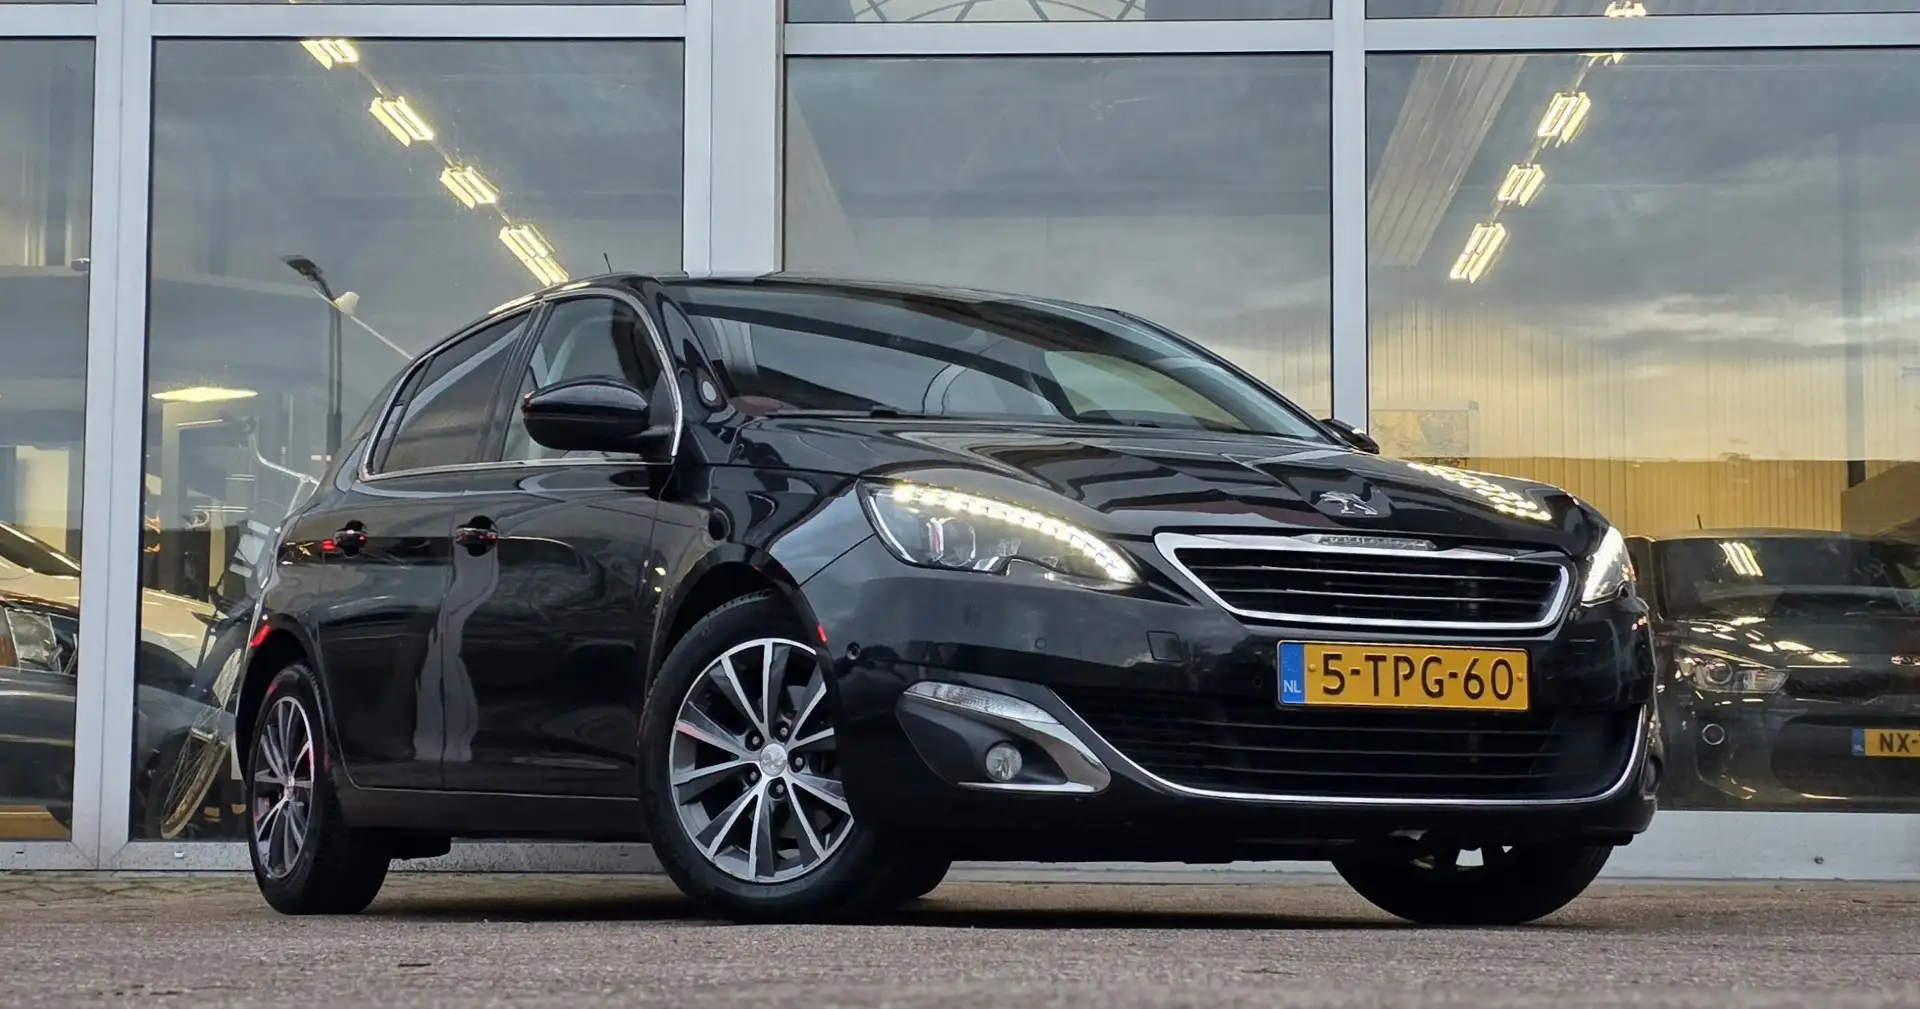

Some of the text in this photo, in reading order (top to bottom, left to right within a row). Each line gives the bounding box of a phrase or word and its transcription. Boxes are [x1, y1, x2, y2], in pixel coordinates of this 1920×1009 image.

[1283, 680, 1301, 693] NL
[1322, 652, 1513, 701] 5-TPG-60
[1879, 732, 1920, 753] NX-
